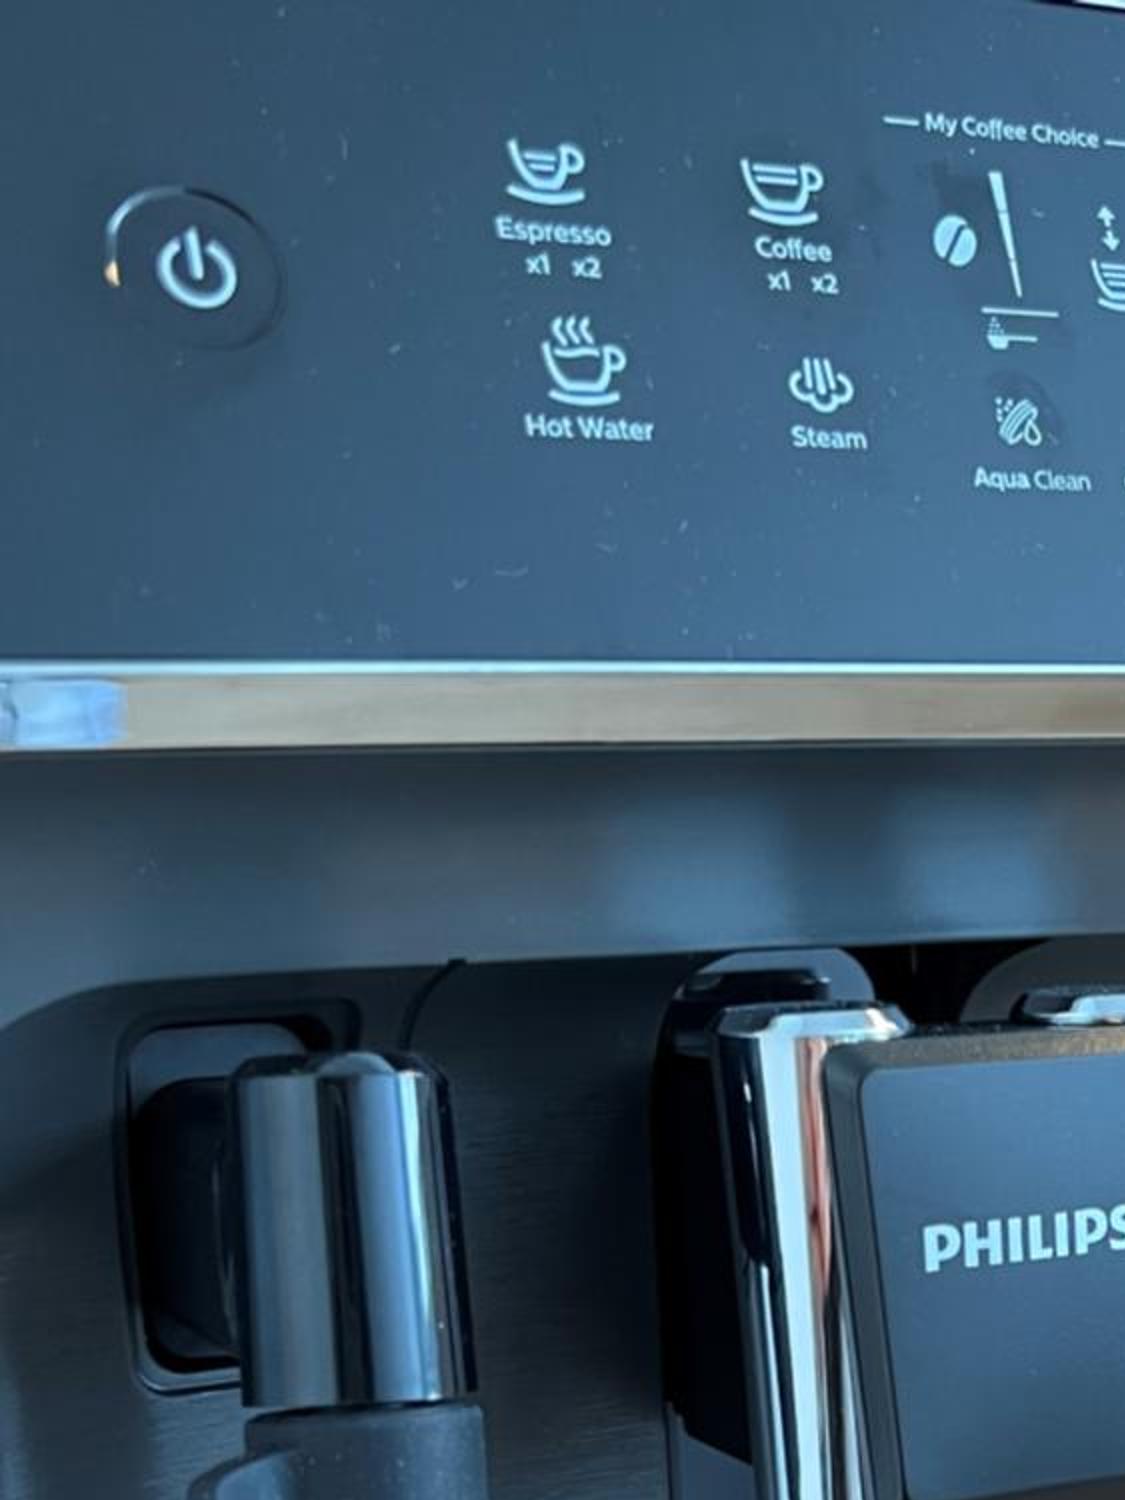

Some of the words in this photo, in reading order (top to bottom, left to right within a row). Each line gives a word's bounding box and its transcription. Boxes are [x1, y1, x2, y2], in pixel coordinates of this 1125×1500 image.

[924, 112, 957, 137] My
[961, 116, 1028, 142] Coffee
[1031, 122, 1099, 149] Choice
[495, 215, 612, 247] Espresso
[754, 235, 833, 263] Coffee
[525, 252, 551, 275] x1
[571, 256, 602, 280] x2
[767, 269, 791, 291] x1
[811, 273, 839, 295] x2
[525, 413, 573, 440] Hot
[577, 415, 654, 442] Water
[790, 424, 868, 450] Steam
[974, 465, 1031, 493] Aqua
[1034, 468, 1092, 491] Clean
